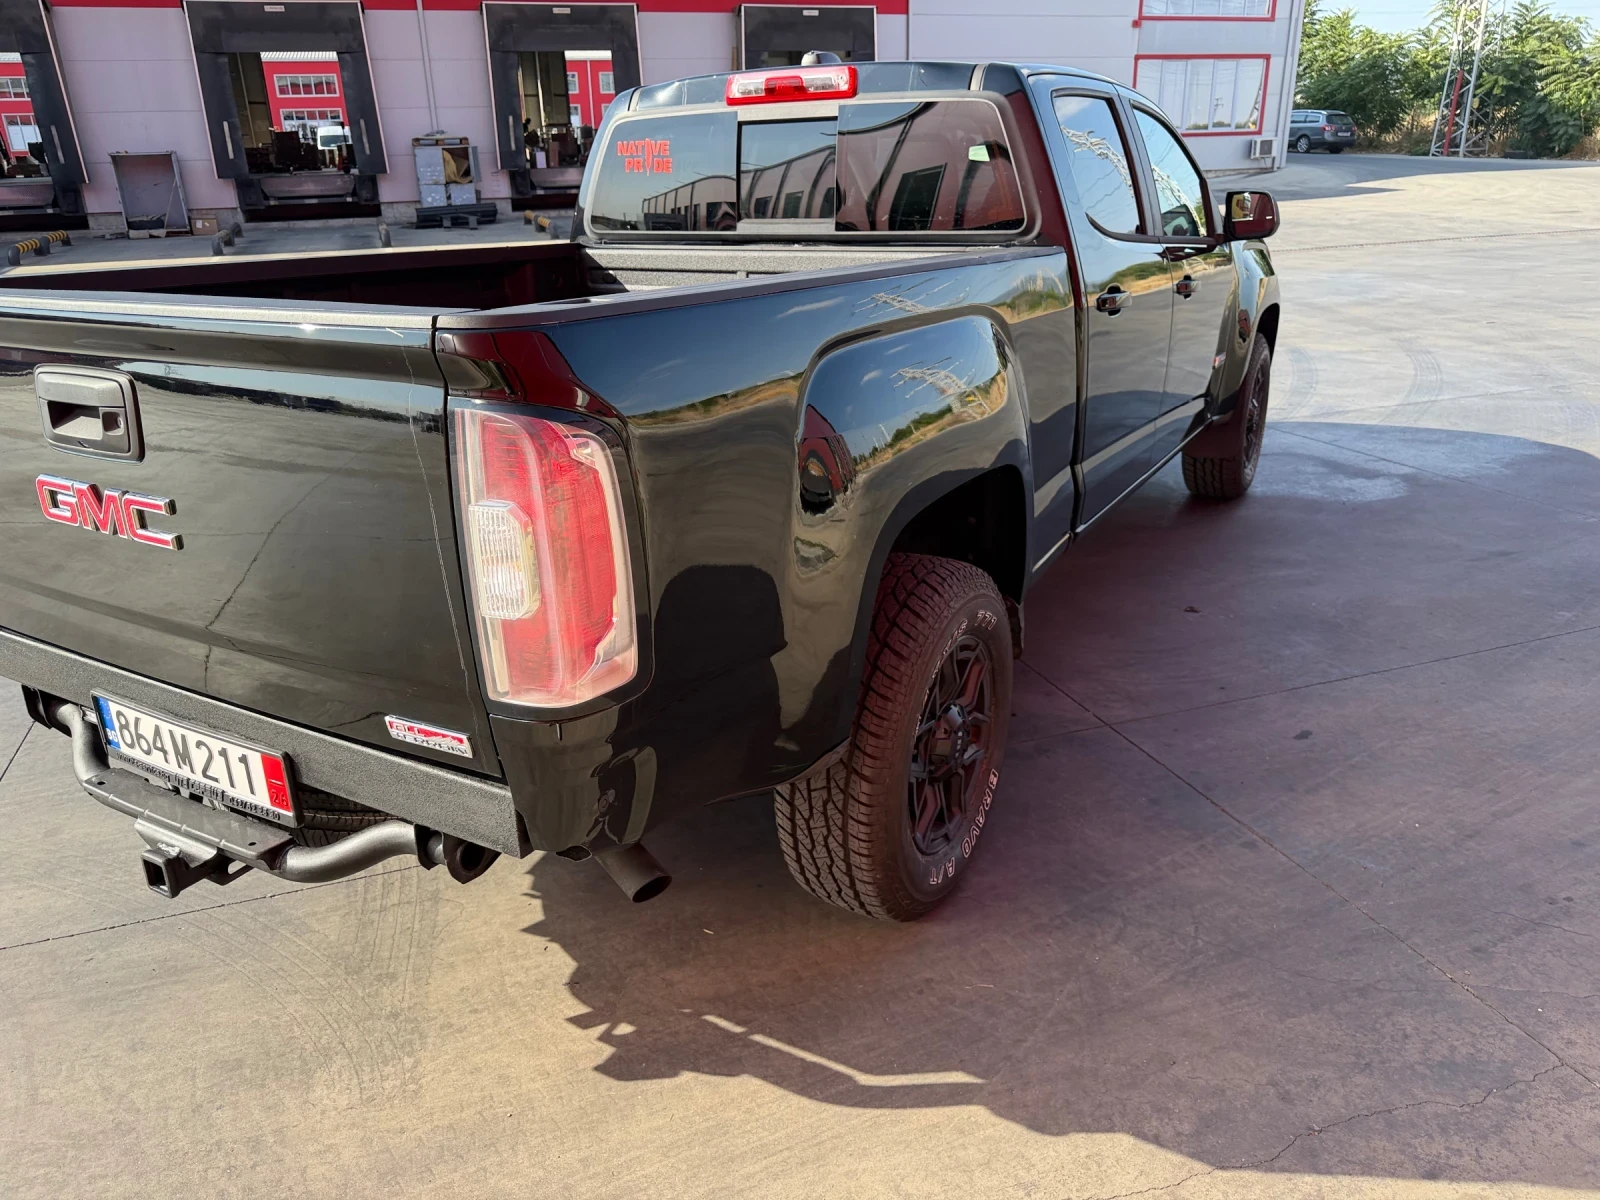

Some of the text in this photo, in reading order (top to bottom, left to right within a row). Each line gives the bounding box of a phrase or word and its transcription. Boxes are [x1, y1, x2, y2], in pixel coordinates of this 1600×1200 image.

[617, 138, 670, 156] NATIVE
[625, 157, 673, 176] PRIDE
[36, 473, 184, 551] GMC
[115, 709, 256, 797] 864M211
[271, 788, 289, 807] 26
[961, 768, 999, 858] BRAVO
[929, 856, 955, 885] A/T
